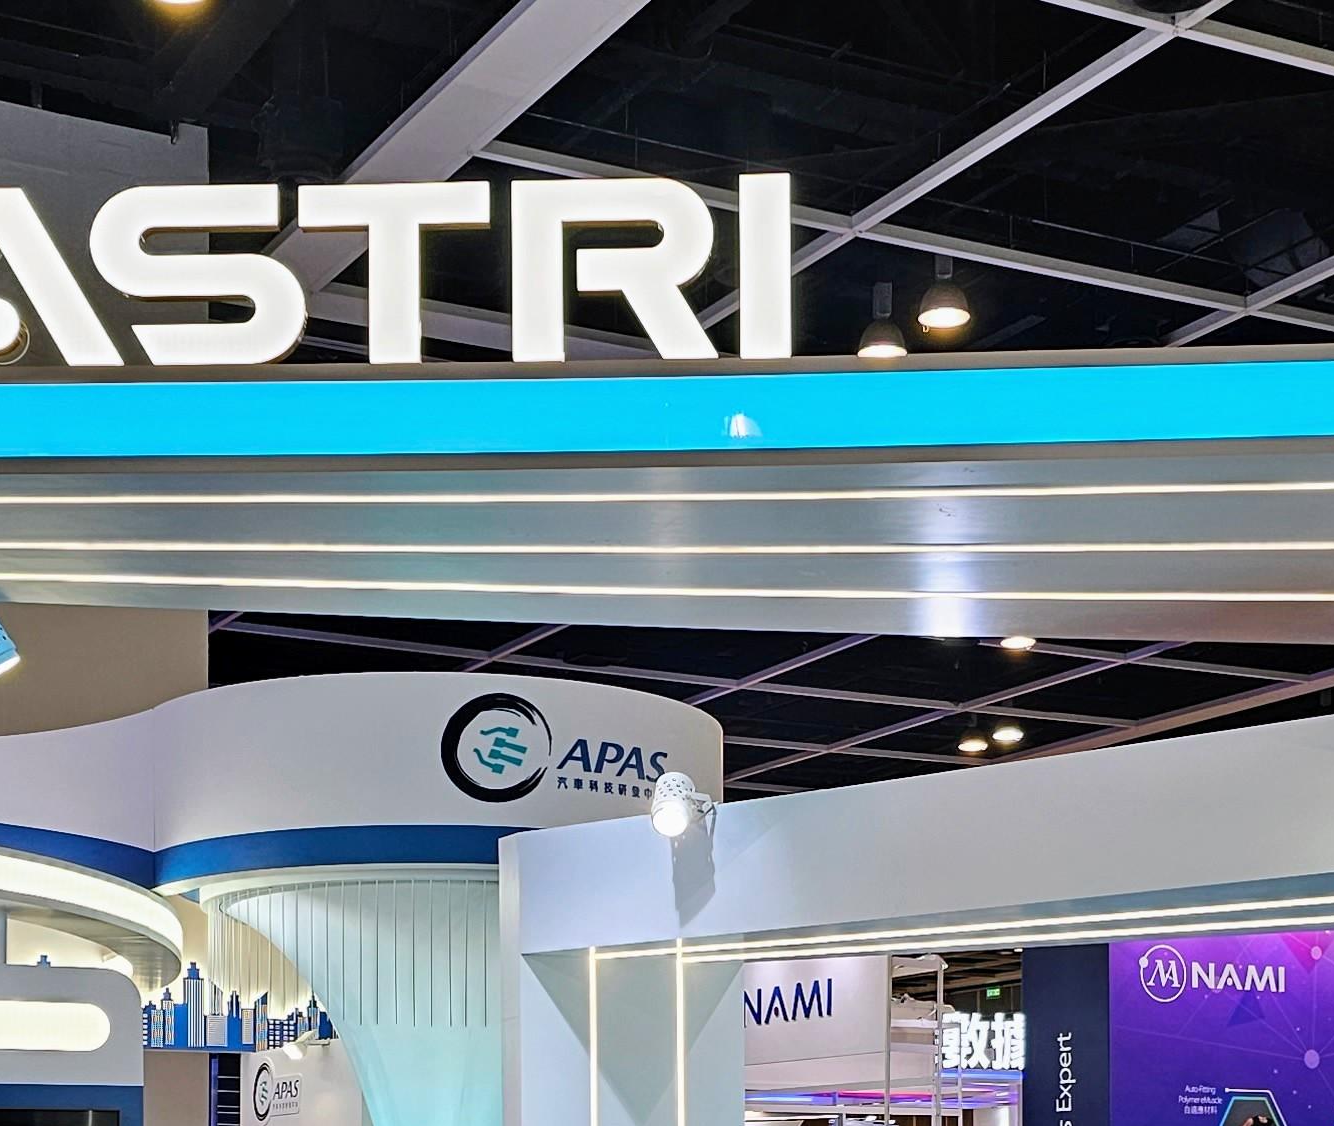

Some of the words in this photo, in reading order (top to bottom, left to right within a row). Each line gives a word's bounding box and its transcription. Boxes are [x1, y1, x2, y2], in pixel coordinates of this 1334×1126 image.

[556, 738, 668, 784] APAS
[1190, 961, 1286, 993] NAMI
[743, 977, 833, 1029] NAMI
[273, 1079, 299, 1101] APAS
[1055, 1032, 1077, 1112] Expert
